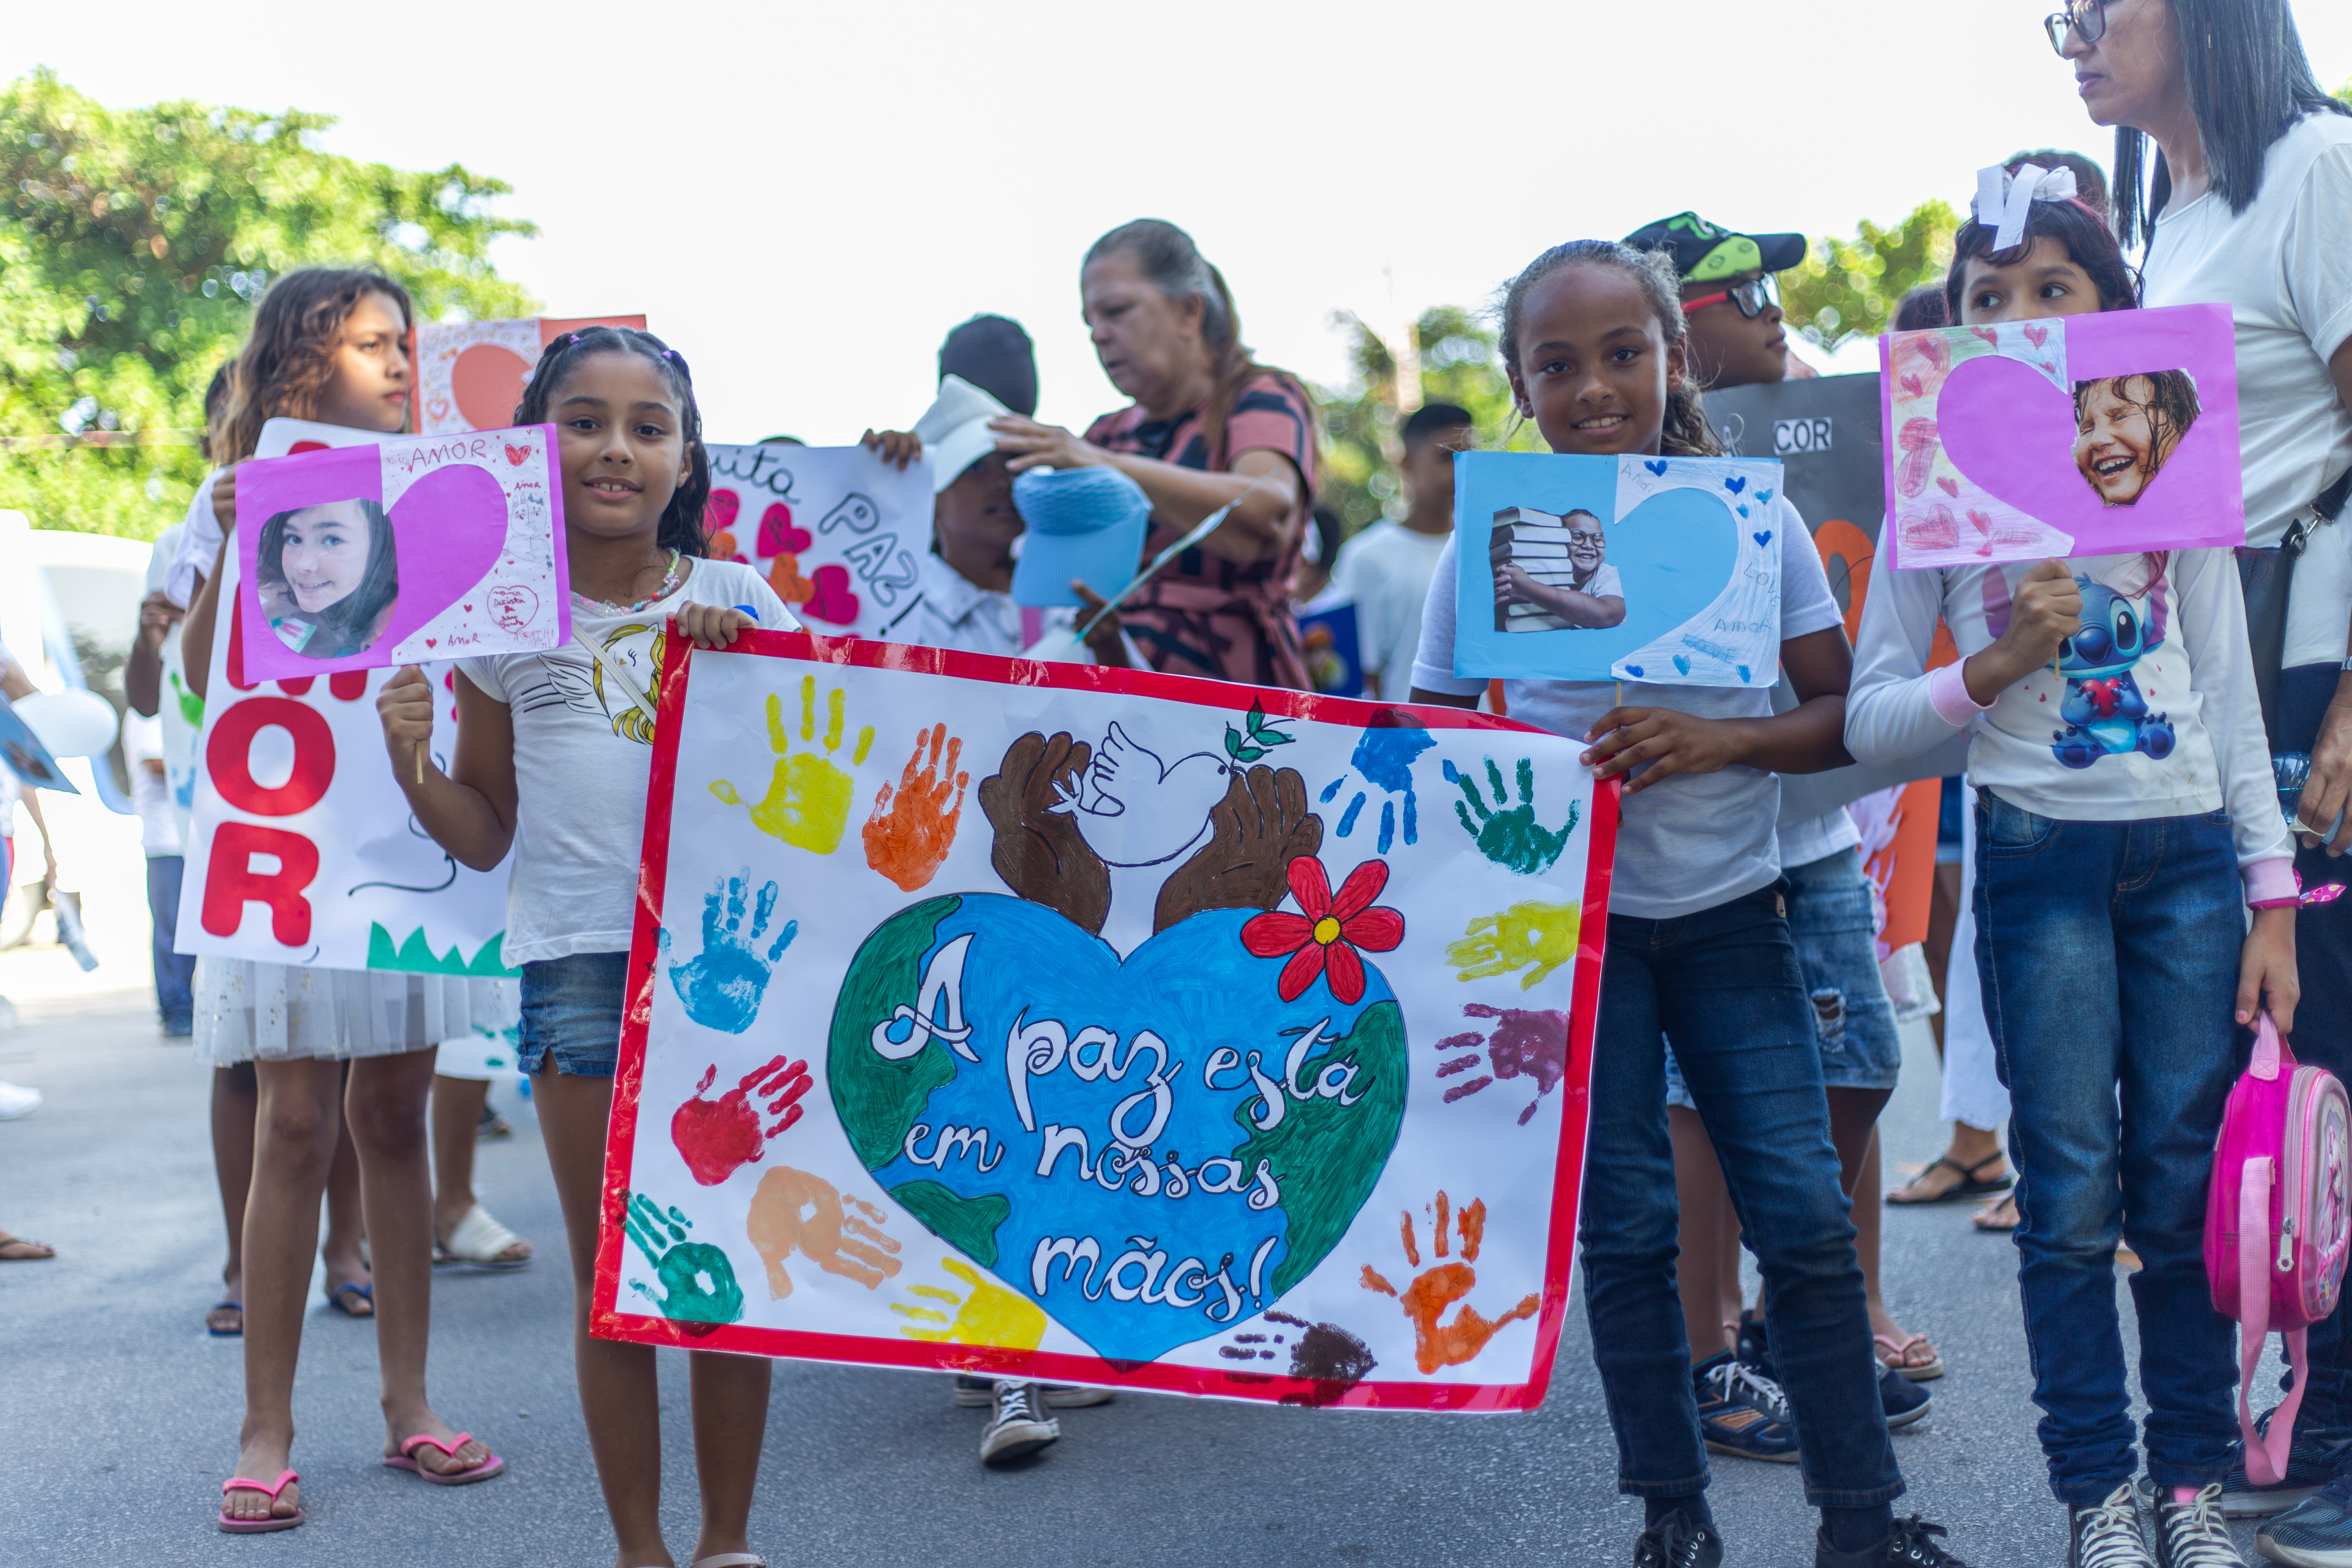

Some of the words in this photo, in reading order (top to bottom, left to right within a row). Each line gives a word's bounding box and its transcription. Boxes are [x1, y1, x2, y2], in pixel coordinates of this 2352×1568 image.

[410, 439, 487, 473] AMOR
[1776, 420, 1829, 451] COR
[710, 448, 801, 504] uita
[871, 933, 981, 1063] A
[1007, 1004, 1184, 1148] paz
[902, 1123, 1006, 1173] em
[1035, 1124, 1286, 1211] nossas
[1032, 1235, 1277, 1322] mãos!
